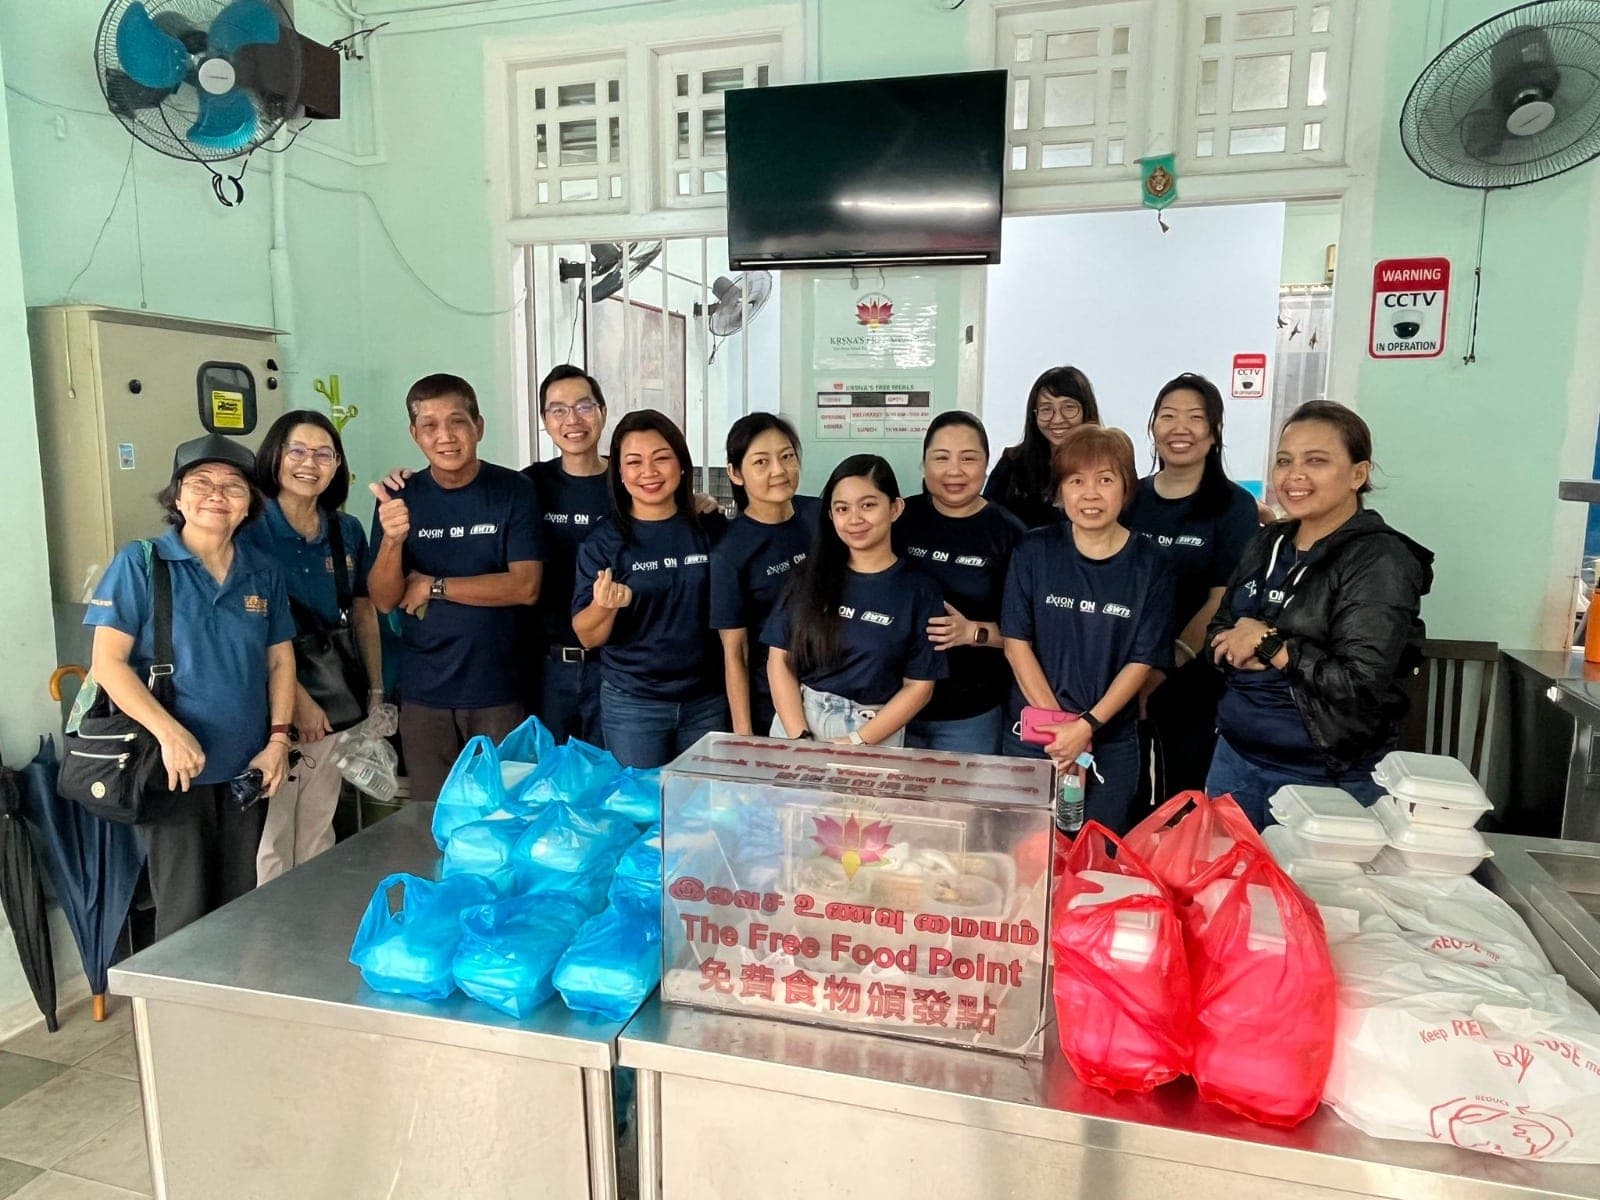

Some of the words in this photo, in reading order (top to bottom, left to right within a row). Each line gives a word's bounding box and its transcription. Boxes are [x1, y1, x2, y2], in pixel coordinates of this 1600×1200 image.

[1382, 268, 1441, 282] WARNING
[1384, 292, 1437, 307] CCTV
[1376, 343, 1385, 351] IN
[1387, 341, 1437, 351] OPERATION
[574, 514, 589, 524] ON
[450, 527, 464, 537] ON
[1158, 535, 1173, 546] ON
[664, 557, 677, 568] ON
[932, 551, 949, 562] ON
[1046, 594, 1075, 607] EXION
[1080, 600, 1095, 613] ON
[838, 605, 855, 618] ON
[754, 760, 790, 770] You
[794, 764, 830, 773] For
[836, 767, 882, 778] Your
[887, 772, 937, 784] Kind
[794, 894, 904, 935] உணவு
[914, 914, 1039, 946] மையம்
[680, 913, 739, 947] The
[748, 923, 821, 959] Free
[831, 933, 917, 974] Food
[928, 947, 1023, 988] Point
[698, 956, 998, 1036] 免費食物頒發點
[1419, 1028, 1449, 1045] Keep
